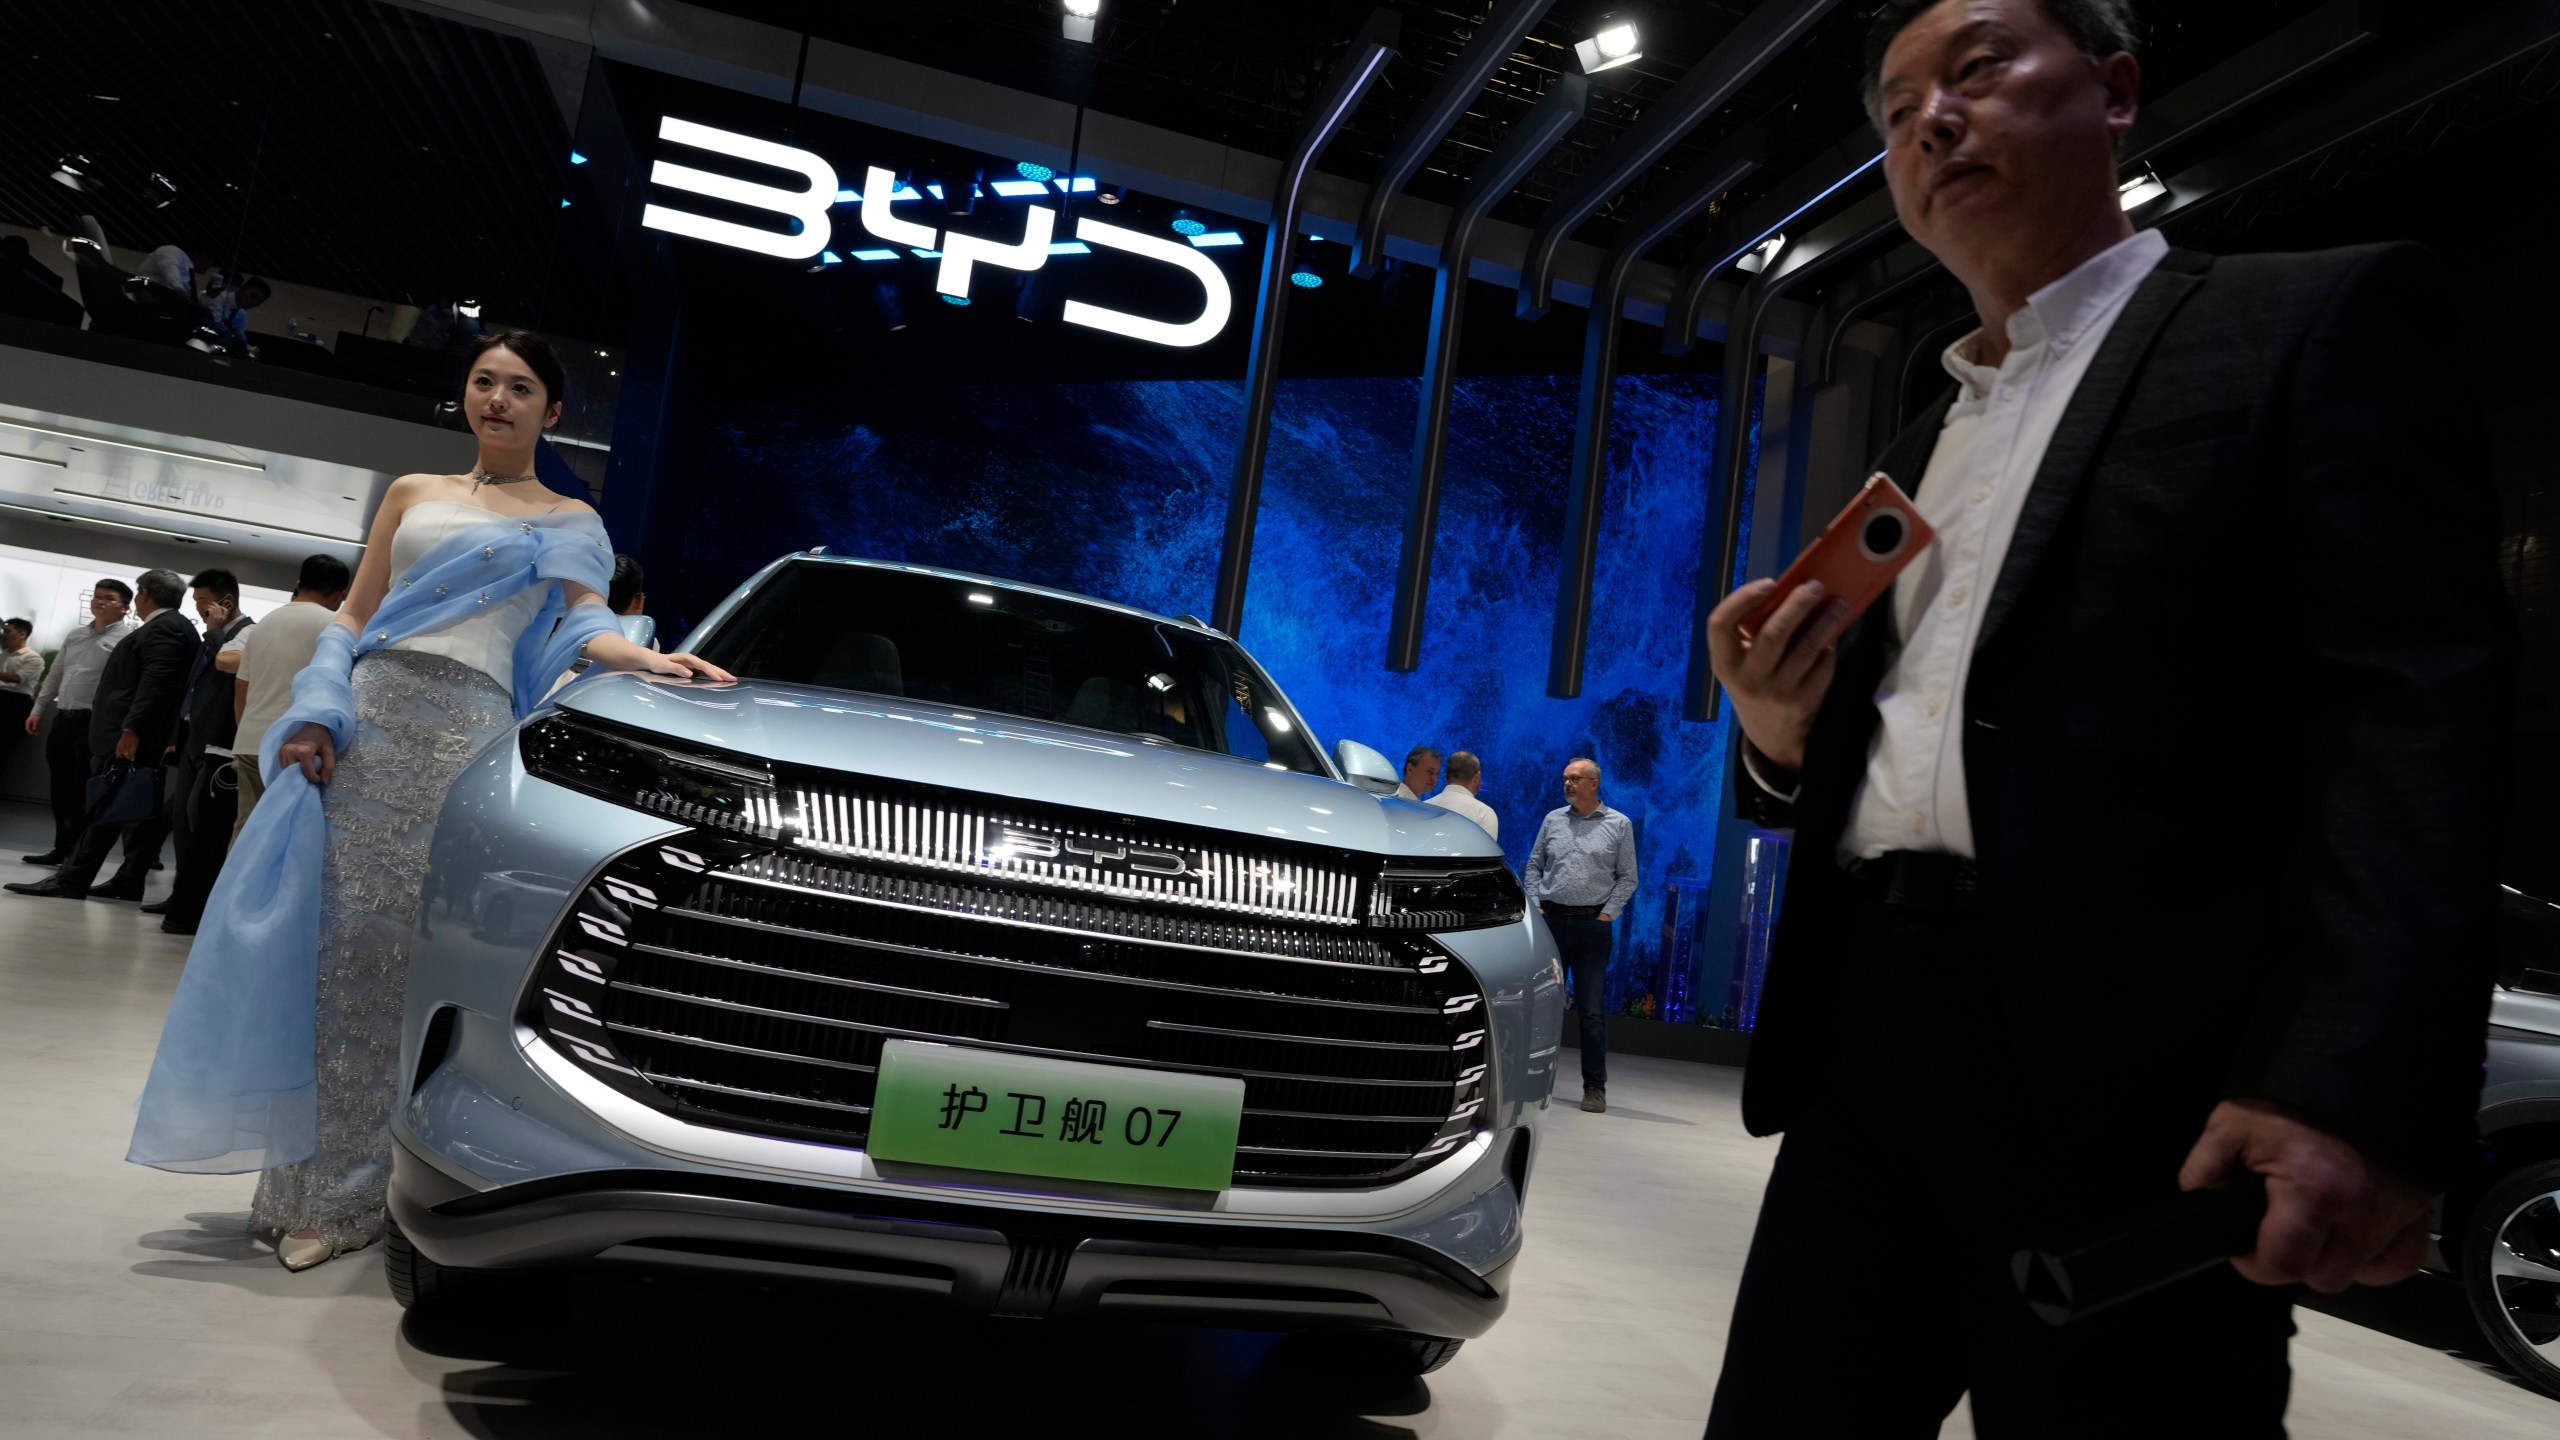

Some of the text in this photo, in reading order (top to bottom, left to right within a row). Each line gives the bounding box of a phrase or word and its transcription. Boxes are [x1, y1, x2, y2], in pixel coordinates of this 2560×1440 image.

[642, 115, 1232, 347] BYD
[999, 828, 1186, 875] BYD
[937, 1083, 1182, 1148] 护卫舰 07
